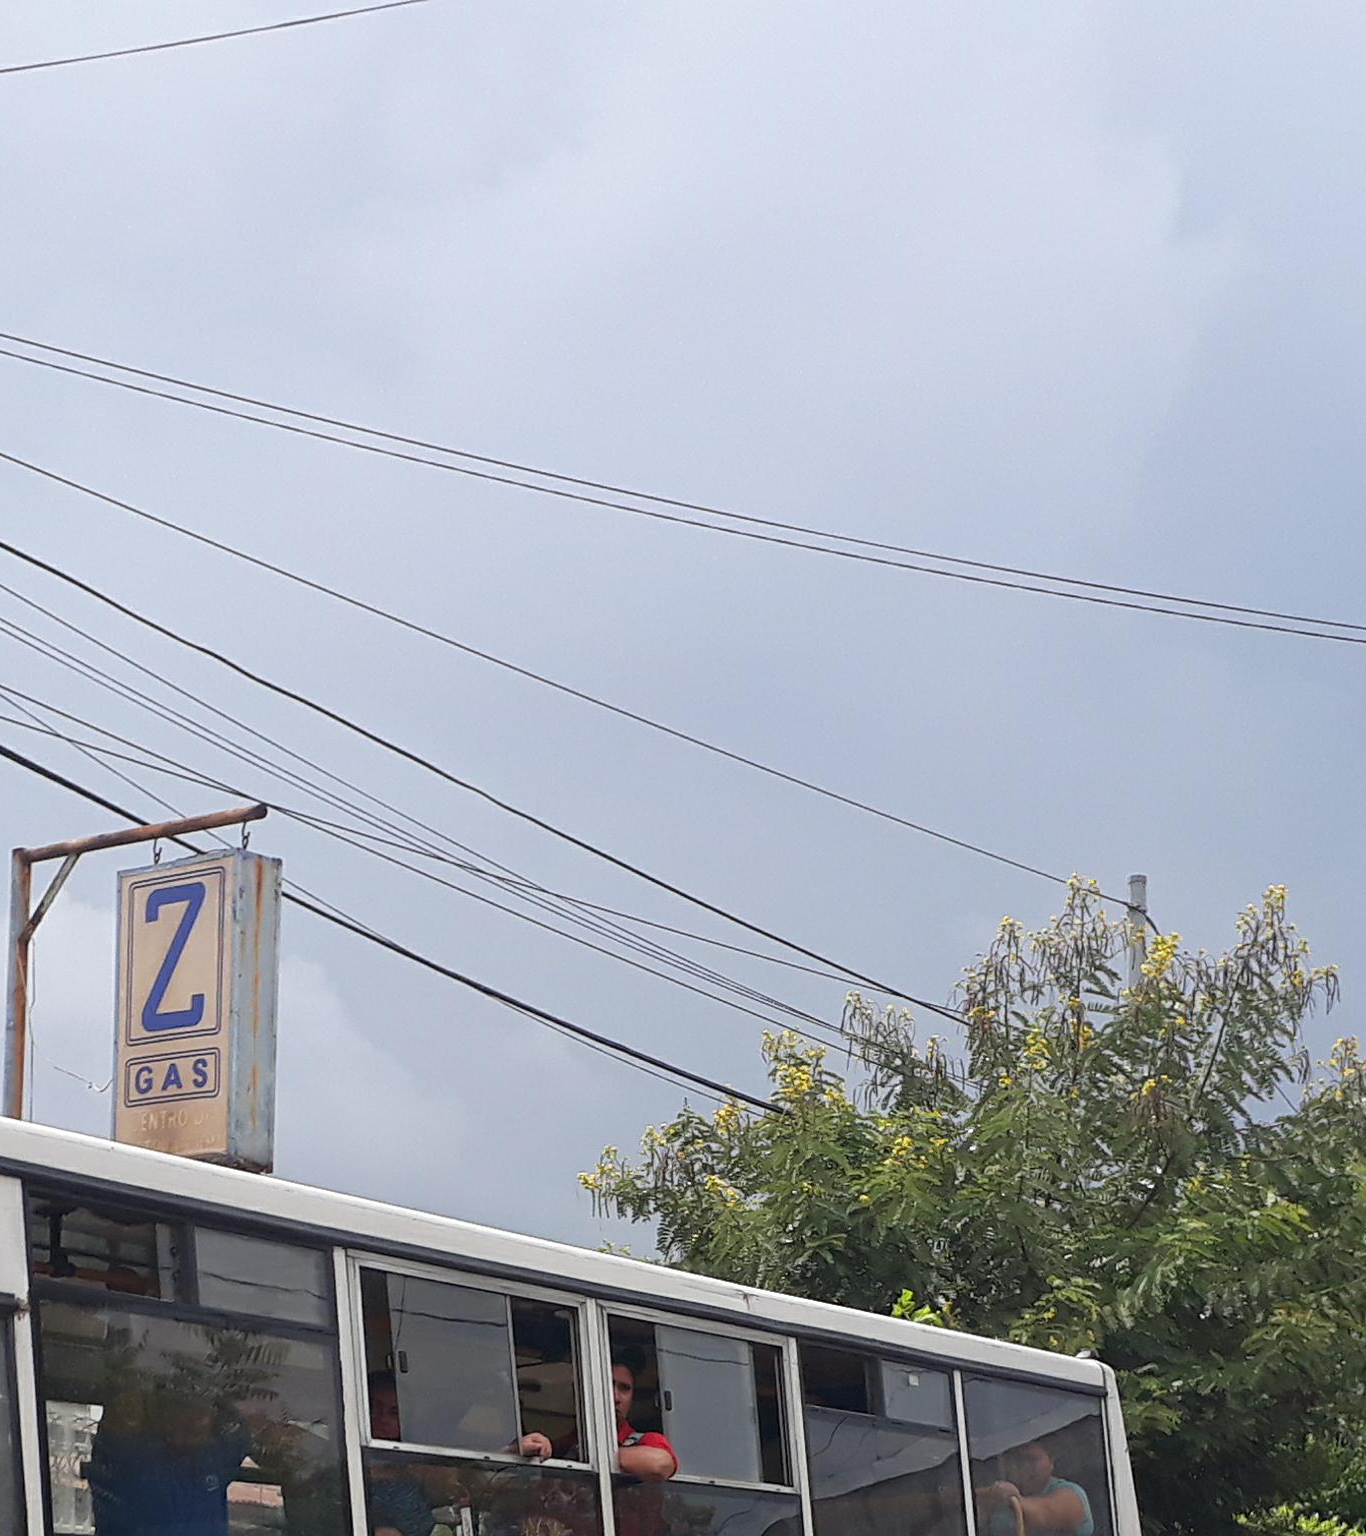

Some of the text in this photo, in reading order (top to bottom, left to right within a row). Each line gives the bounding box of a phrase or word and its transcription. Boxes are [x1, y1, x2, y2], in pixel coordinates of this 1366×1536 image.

[142, 881, 206, 1033] Z
[135, 1058, 209, 1095] GAS
[133, 1108, 188, 1133] ENTRO
